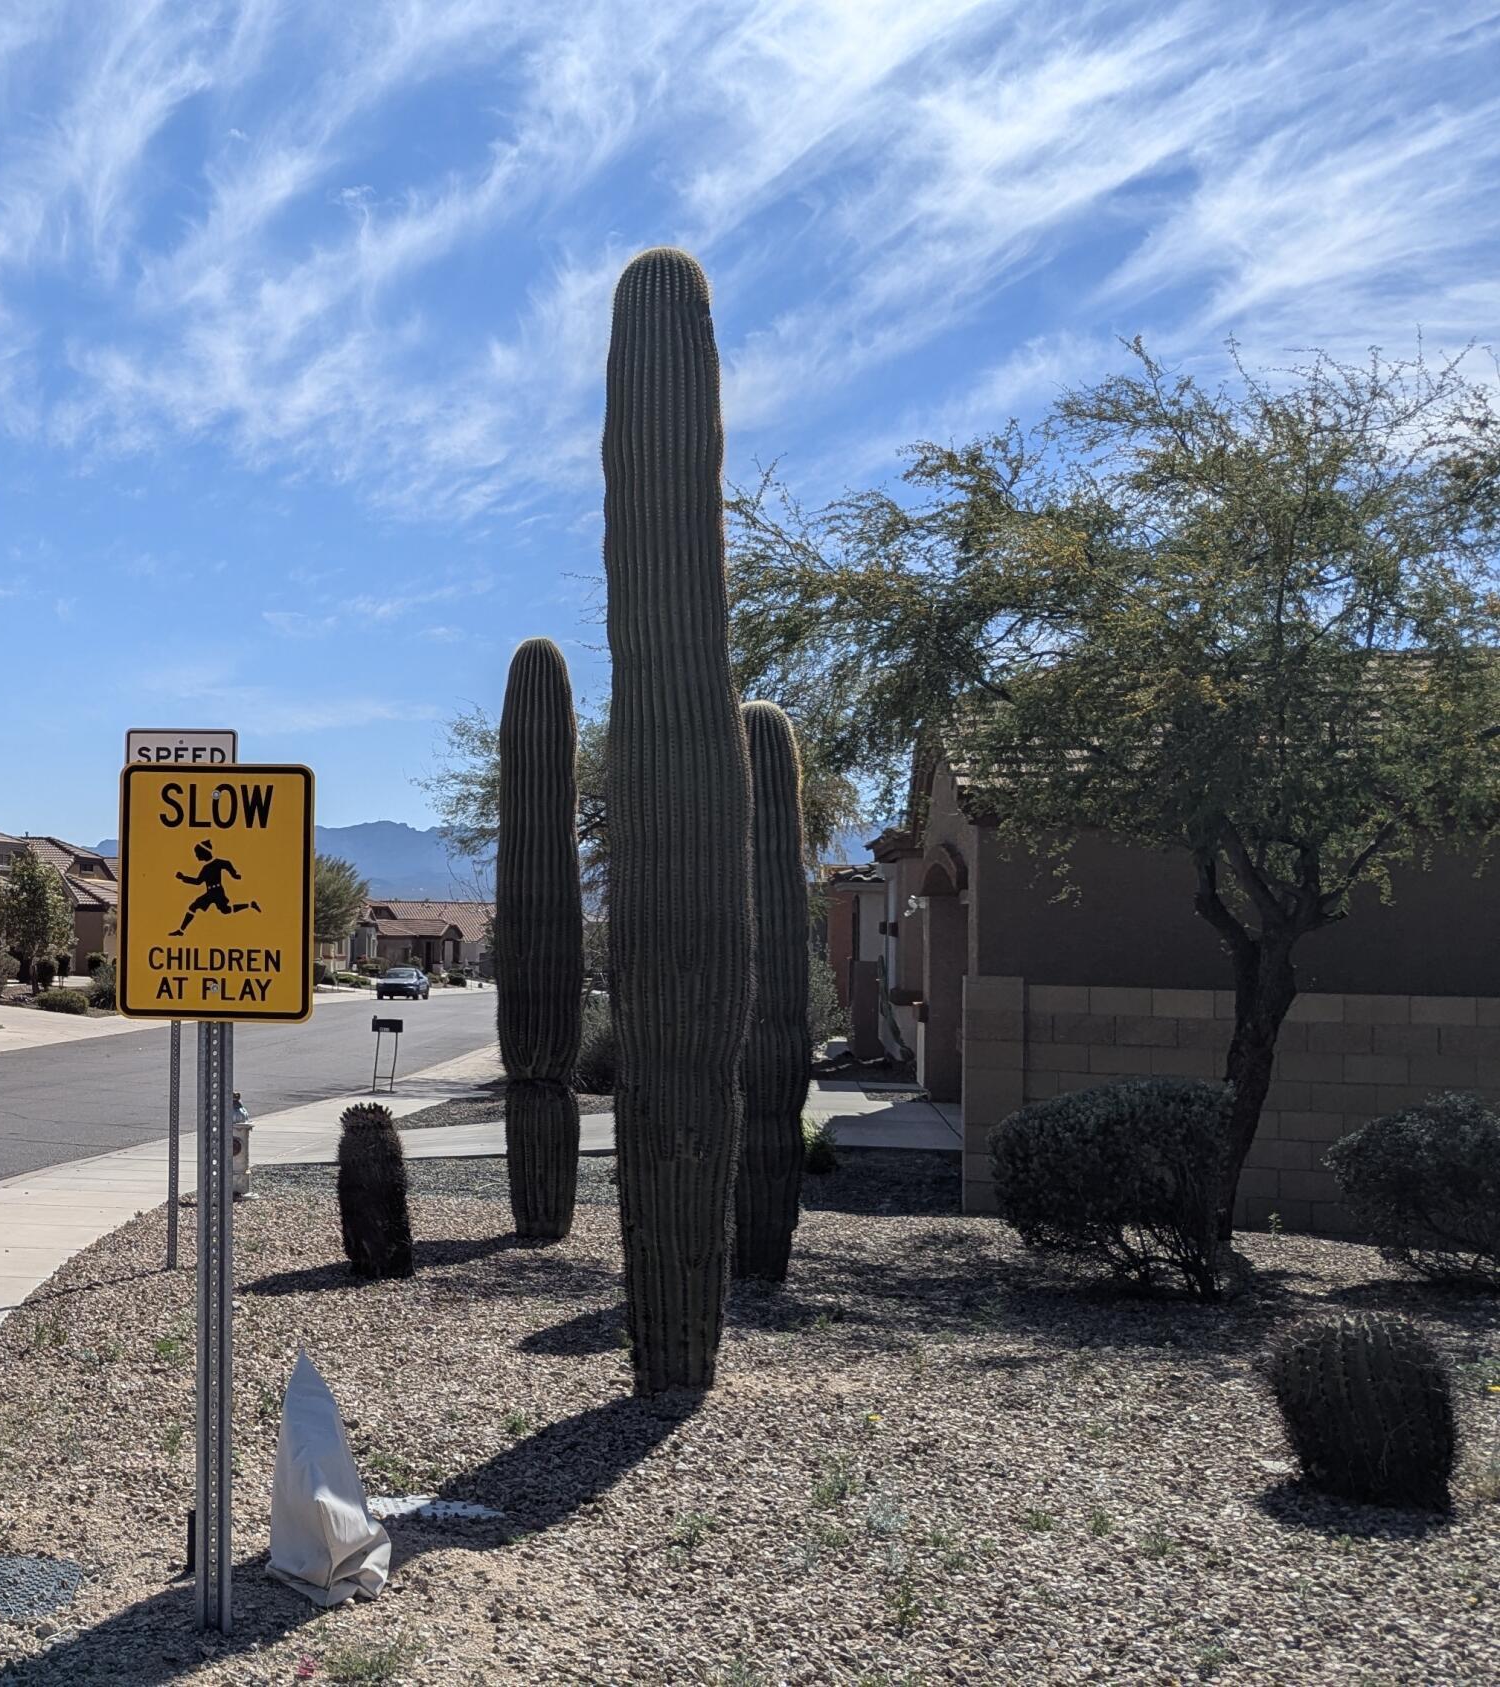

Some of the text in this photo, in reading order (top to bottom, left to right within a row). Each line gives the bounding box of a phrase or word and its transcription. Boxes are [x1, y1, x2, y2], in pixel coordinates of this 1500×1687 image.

[137, 746, 226, 763] SPEED
[159, 782, 274, 829] SLOW
[148, 946, 281, 972] CHILDREN
[156, 976, 272, 1001] AT PLAY
